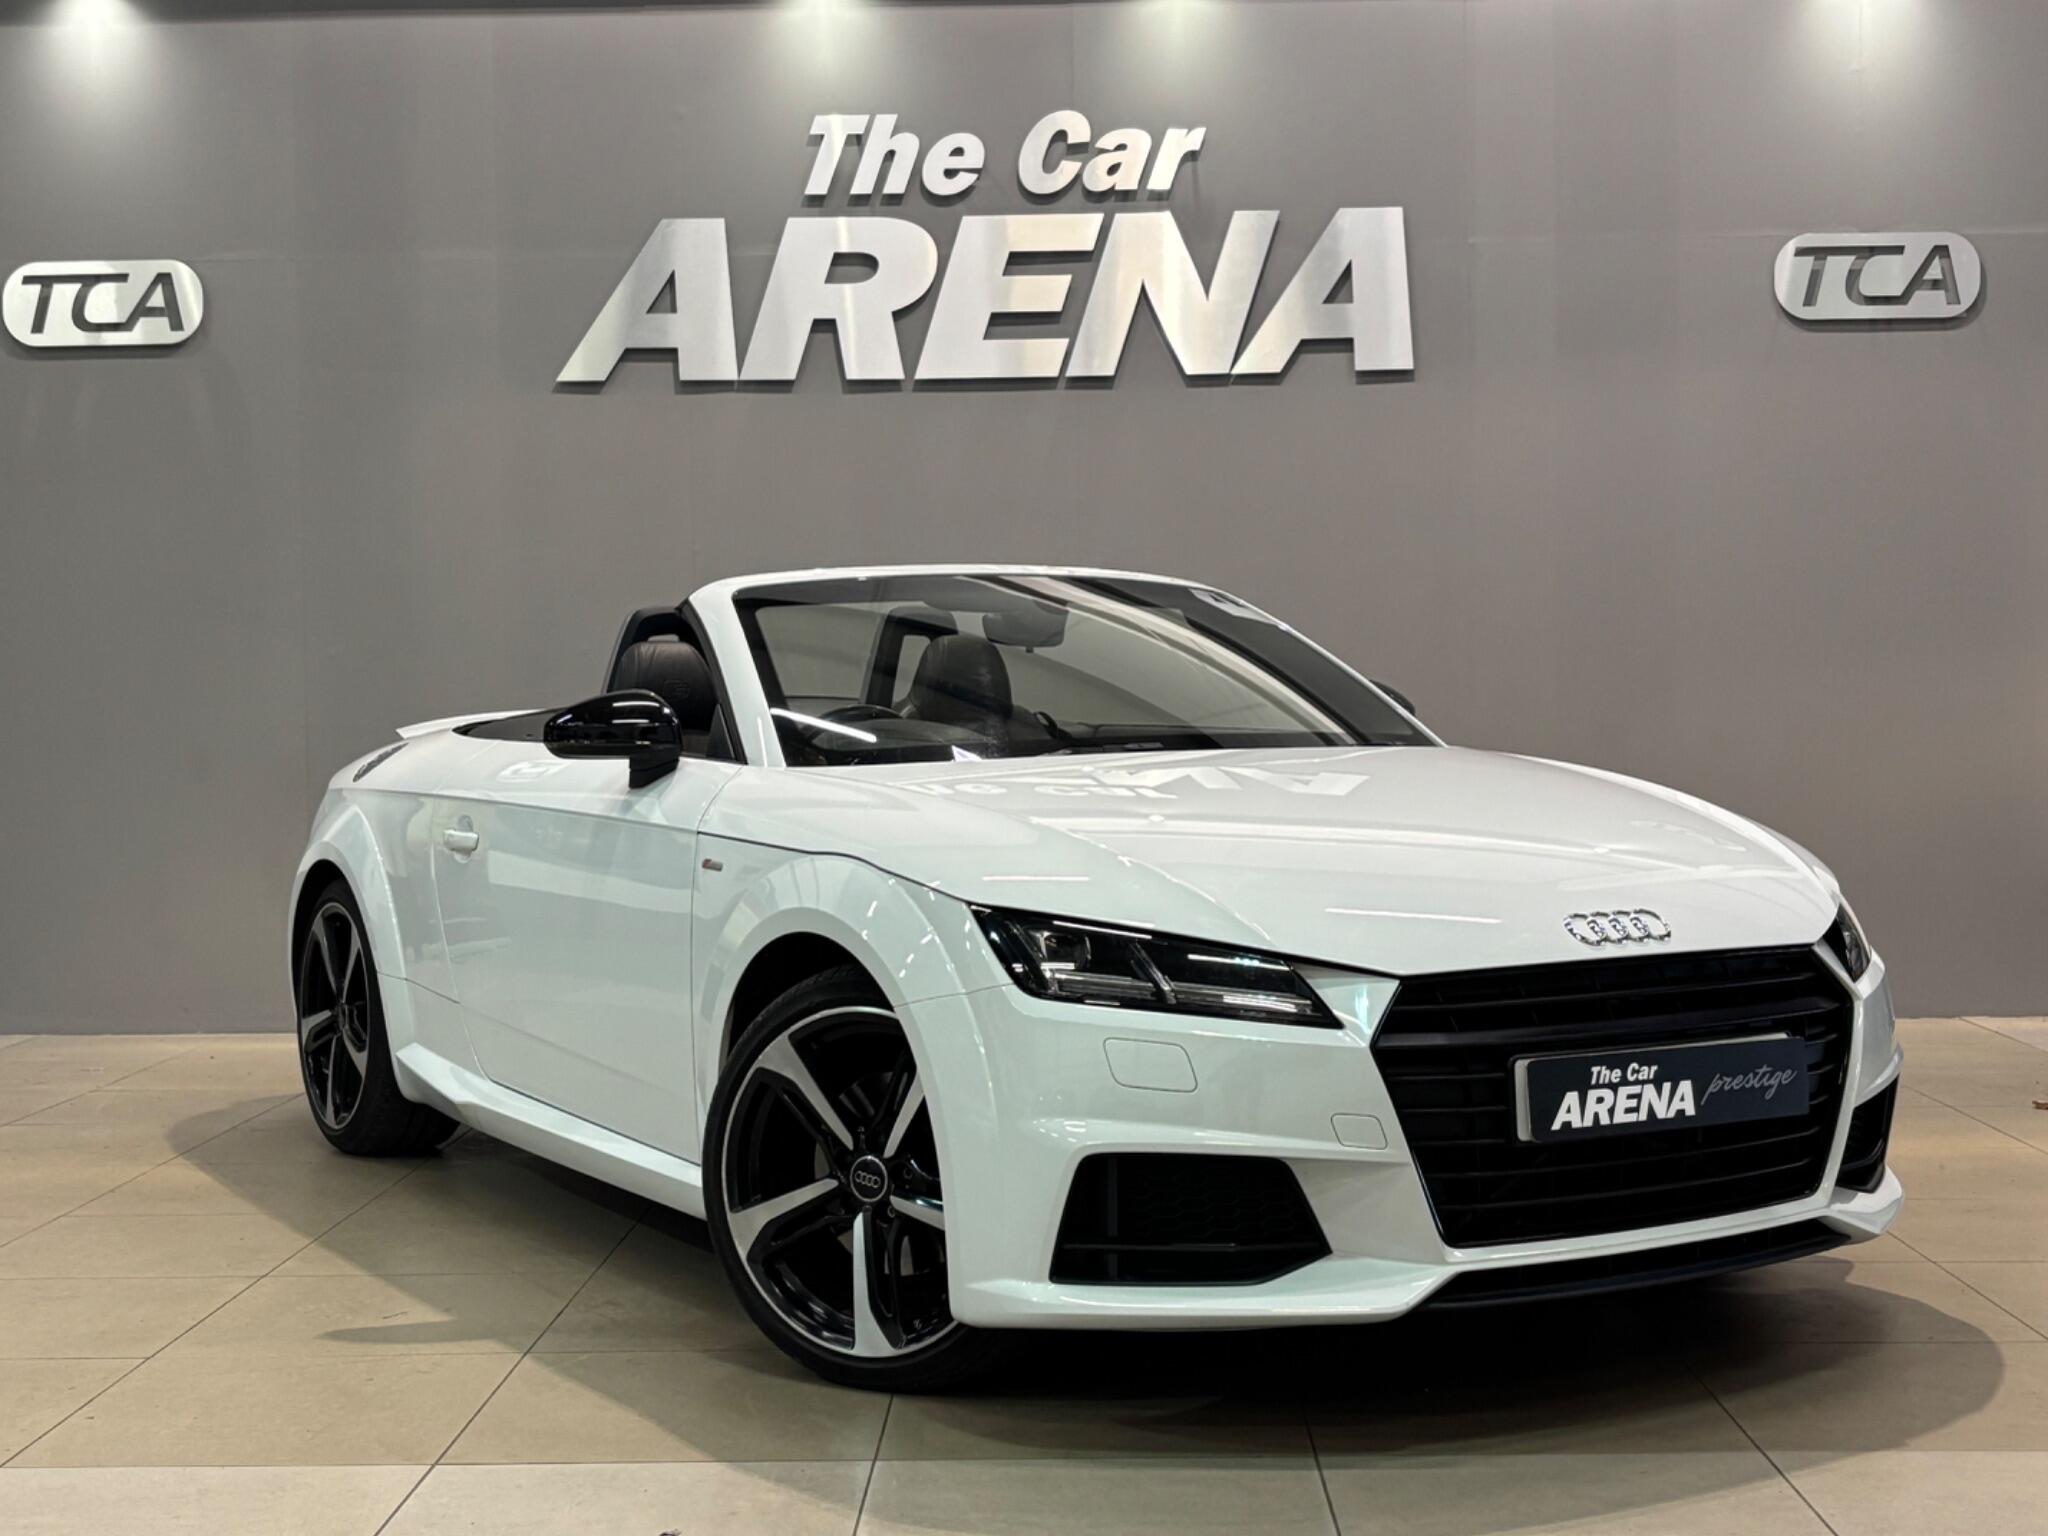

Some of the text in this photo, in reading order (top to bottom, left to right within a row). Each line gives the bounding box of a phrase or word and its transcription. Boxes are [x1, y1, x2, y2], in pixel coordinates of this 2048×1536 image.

[804, 109, 1206, 198] The Car
[21, 271, 185, 334] TCA
[556, 206, 1415, 382] ARENA
[1794, 244, 1961, 307] TCA
[1551, 1079, 1696, 1131] ARENA
[1590, 1062, 1658, 1085] The Car
[1701, 1064, 1798, 1106] prestige
